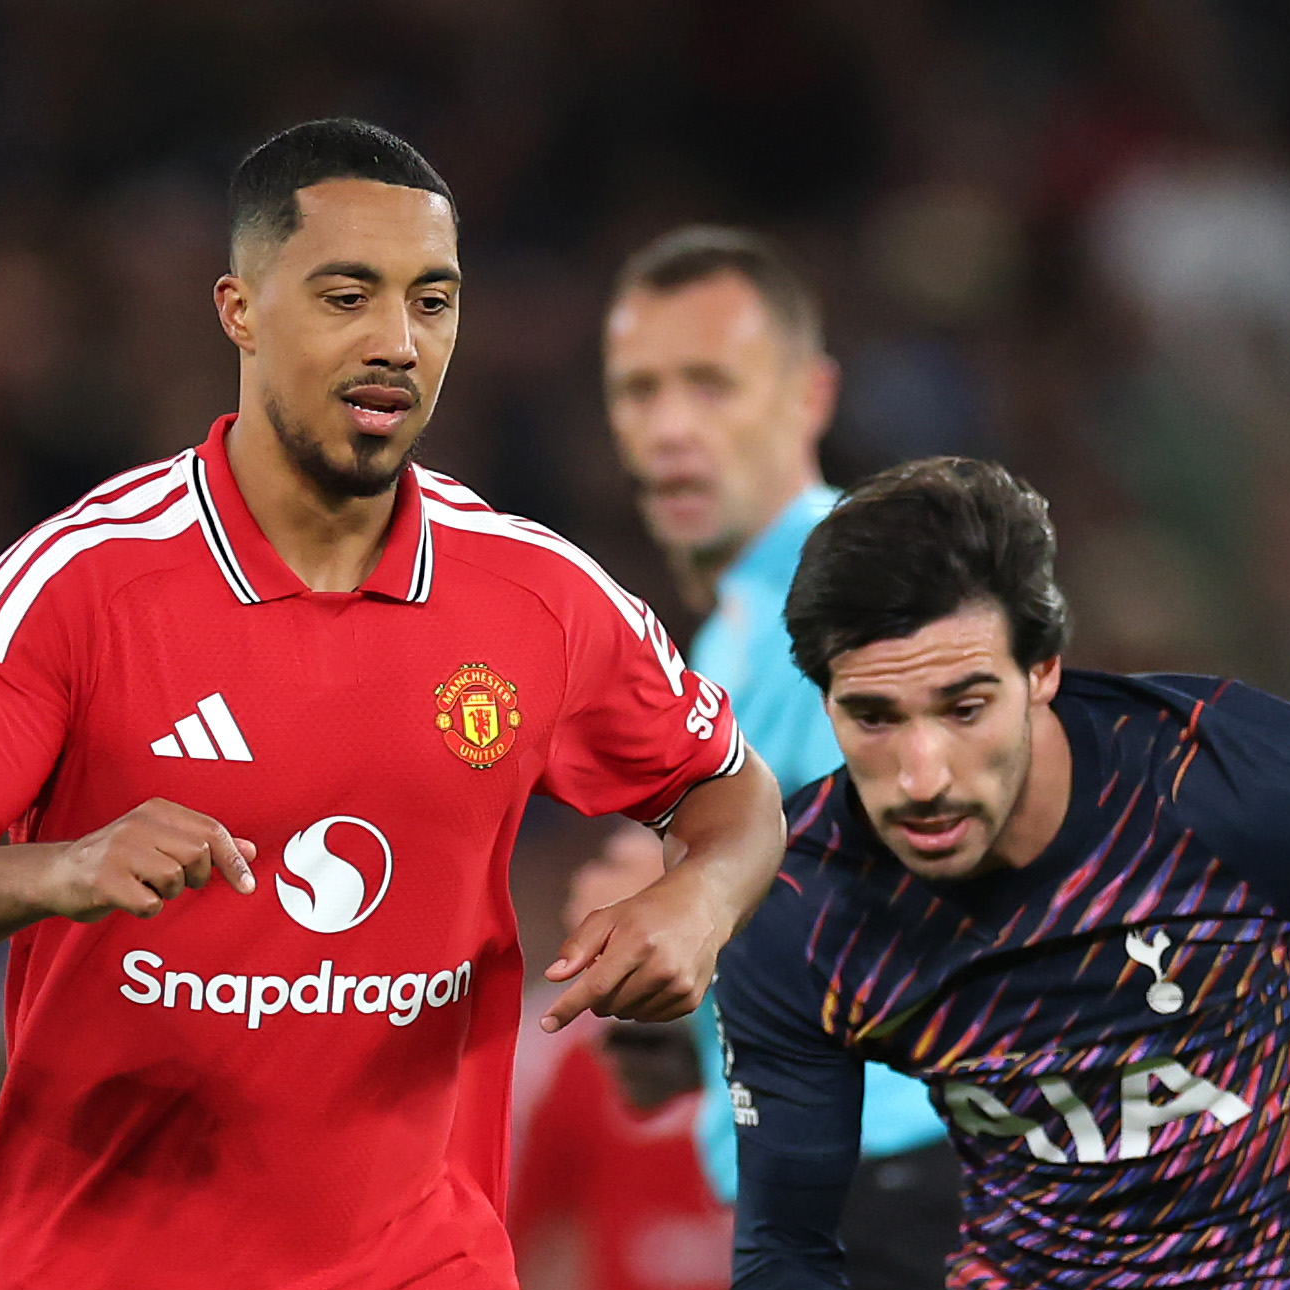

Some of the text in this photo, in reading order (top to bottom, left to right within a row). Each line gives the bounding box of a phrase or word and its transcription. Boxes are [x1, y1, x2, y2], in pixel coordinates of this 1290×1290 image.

[442, 671, 512, 705] MANCHESTER
[459, 743, 505, 761] UNITED
[119, 950, 472, 1030] Snapdragon
[944, 1057, 1252, 1164] AIA
